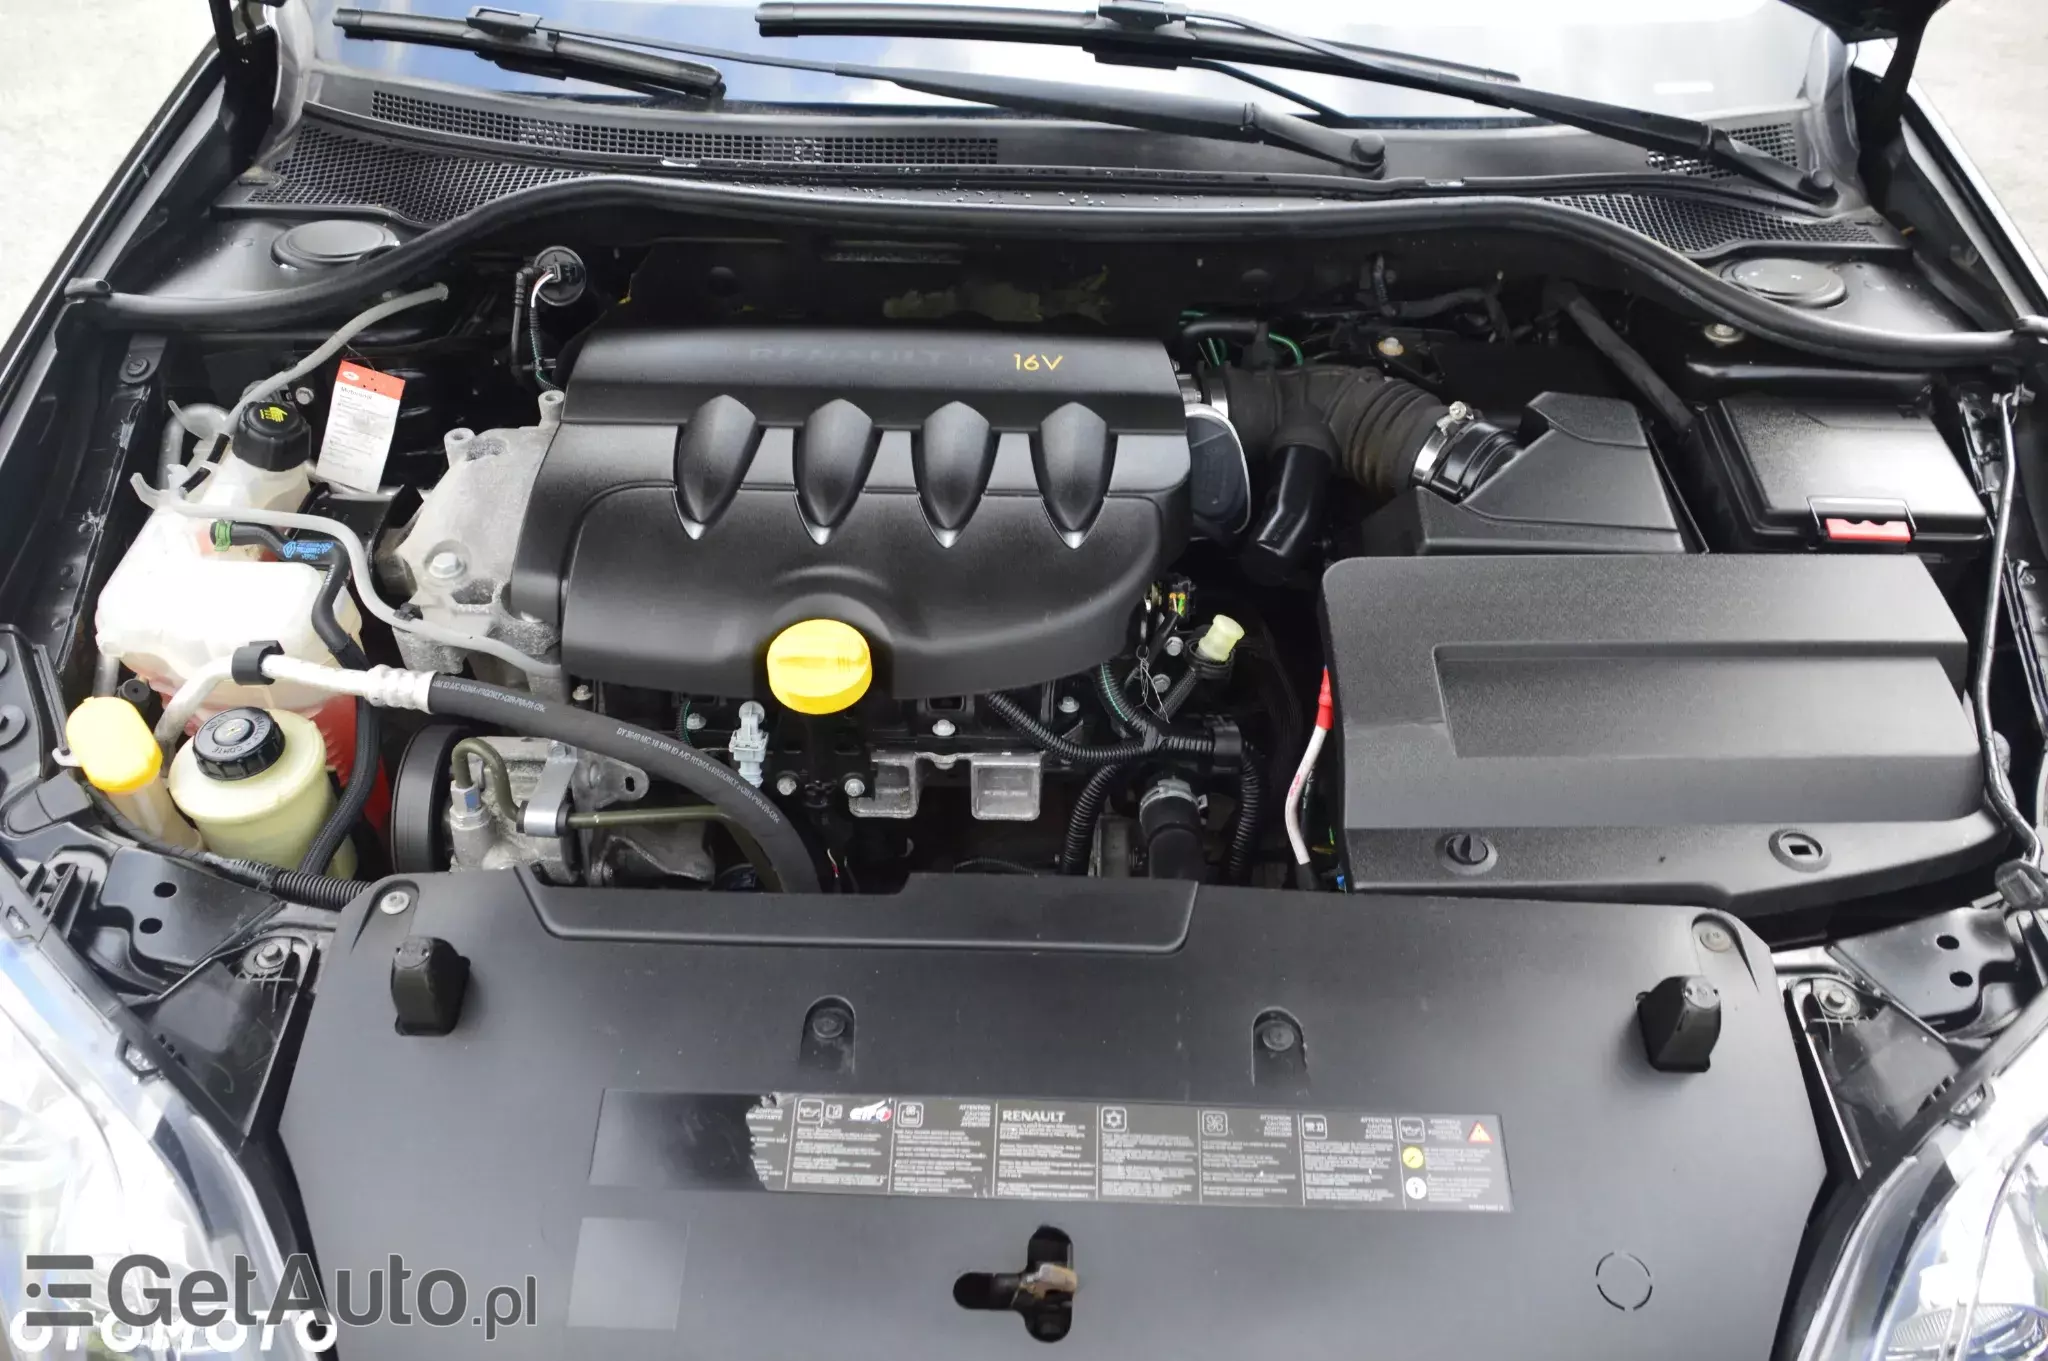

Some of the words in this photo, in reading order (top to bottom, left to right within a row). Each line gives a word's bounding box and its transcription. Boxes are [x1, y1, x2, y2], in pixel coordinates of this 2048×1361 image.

[1012, 352, 1064, 371] 16V
[616, 727, 626, 736] DY
[679, 750, 691, 761] A/C
[1002, 1110, 1065, 1122] RENAULT
